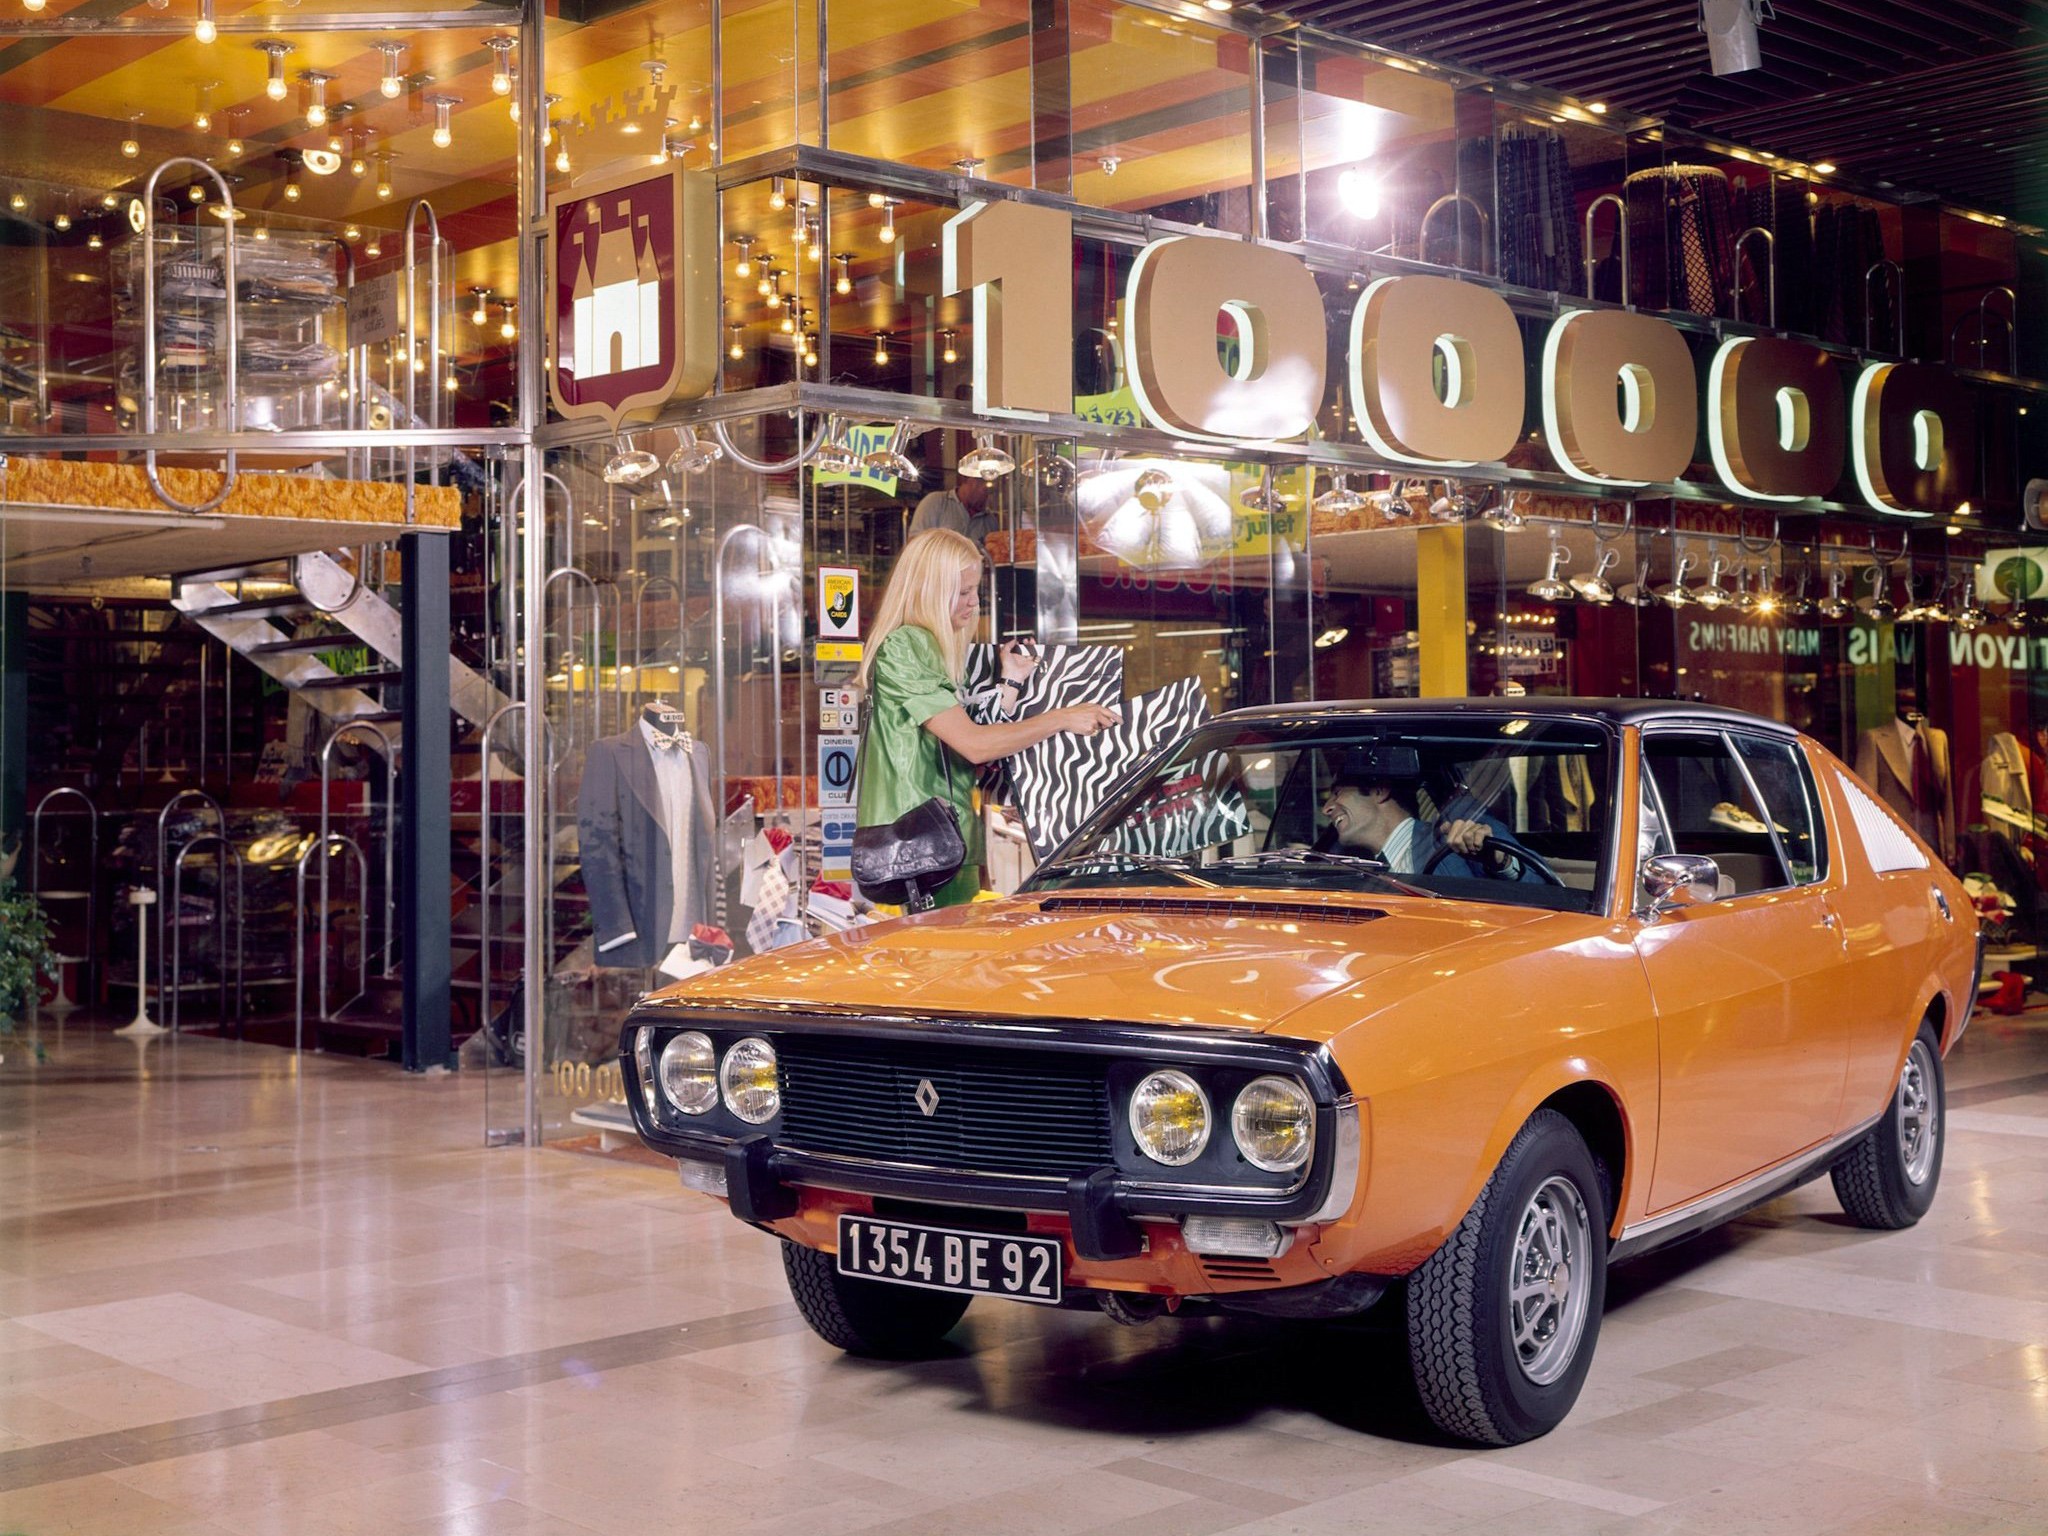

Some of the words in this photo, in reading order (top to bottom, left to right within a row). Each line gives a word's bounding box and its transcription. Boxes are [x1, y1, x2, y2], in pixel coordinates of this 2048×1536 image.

[1246, 514, 1295, 542] juillet
[824, 738, 853, 746] DINERS
[551, 1060, 590, 1099] 100
[849, 1223, 933, 1281] 1354
[944, 1235, 990, 1289] BE
[1002, 1243, 1051, 1296] 92
